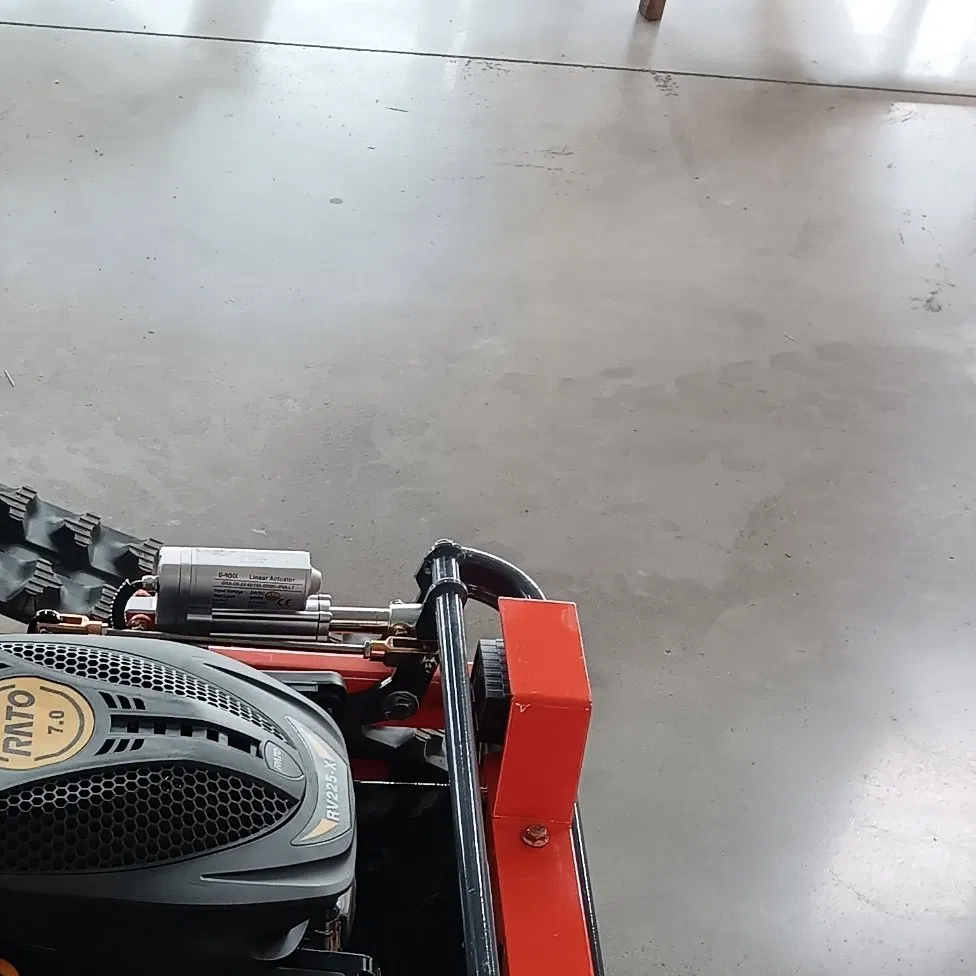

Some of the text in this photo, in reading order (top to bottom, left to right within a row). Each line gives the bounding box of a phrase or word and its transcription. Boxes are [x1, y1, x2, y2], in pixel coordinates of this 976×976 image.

[249, 573, 268, 581] Linear
[270, 575, 296, 583] Actuator
[3, 690, 36, 756] RATO
[48, 710, 65, 735] 7.0
